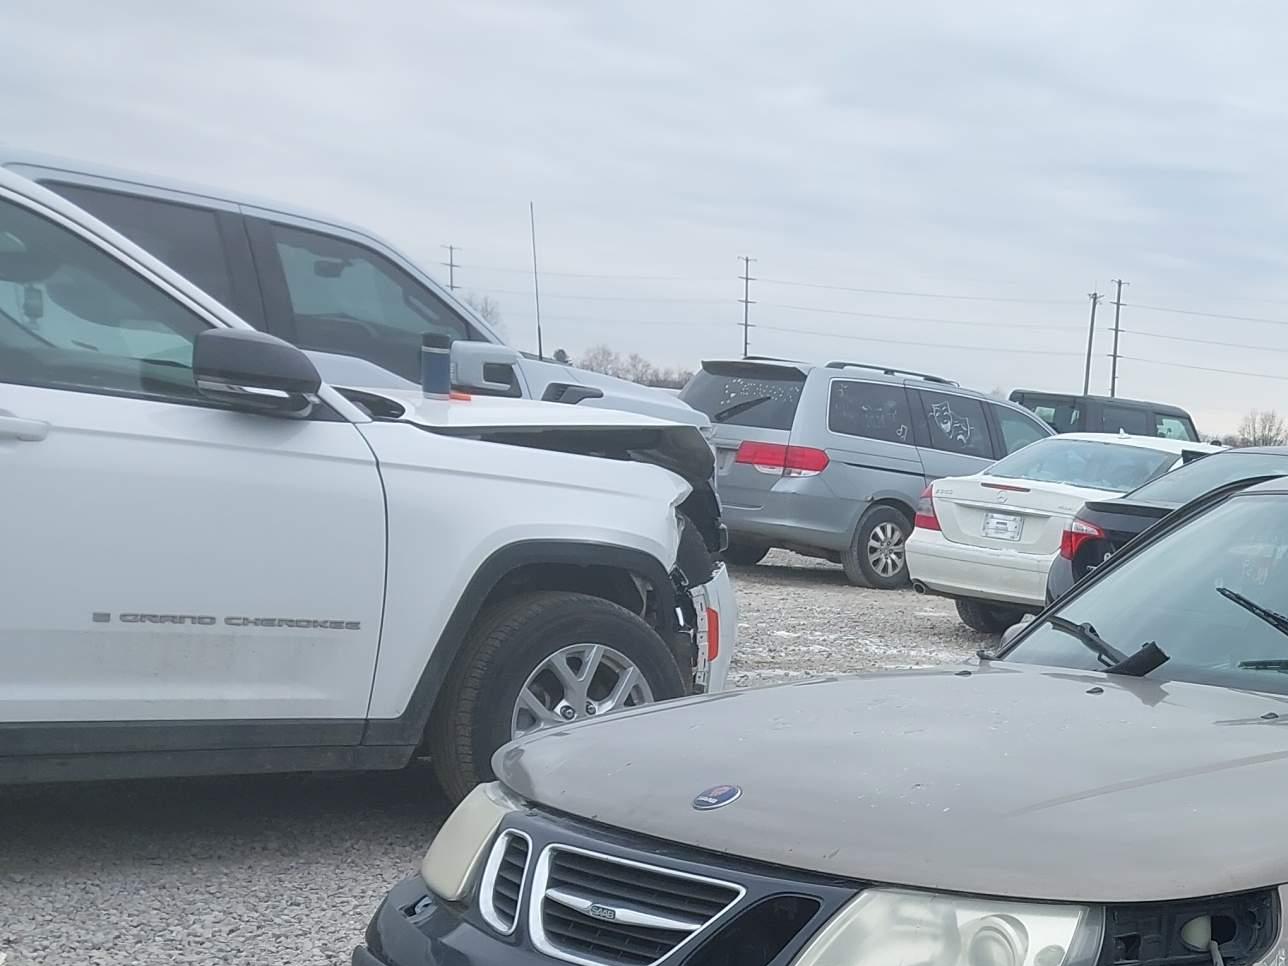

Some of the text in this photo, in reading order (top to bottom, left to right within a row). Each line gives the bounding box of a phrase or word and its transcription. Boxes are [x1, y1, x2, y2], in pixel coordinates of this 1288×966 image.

[119, 612, 361, 630] GRAND CHEROKEE
[591, 905, 615, 919] SAAB
